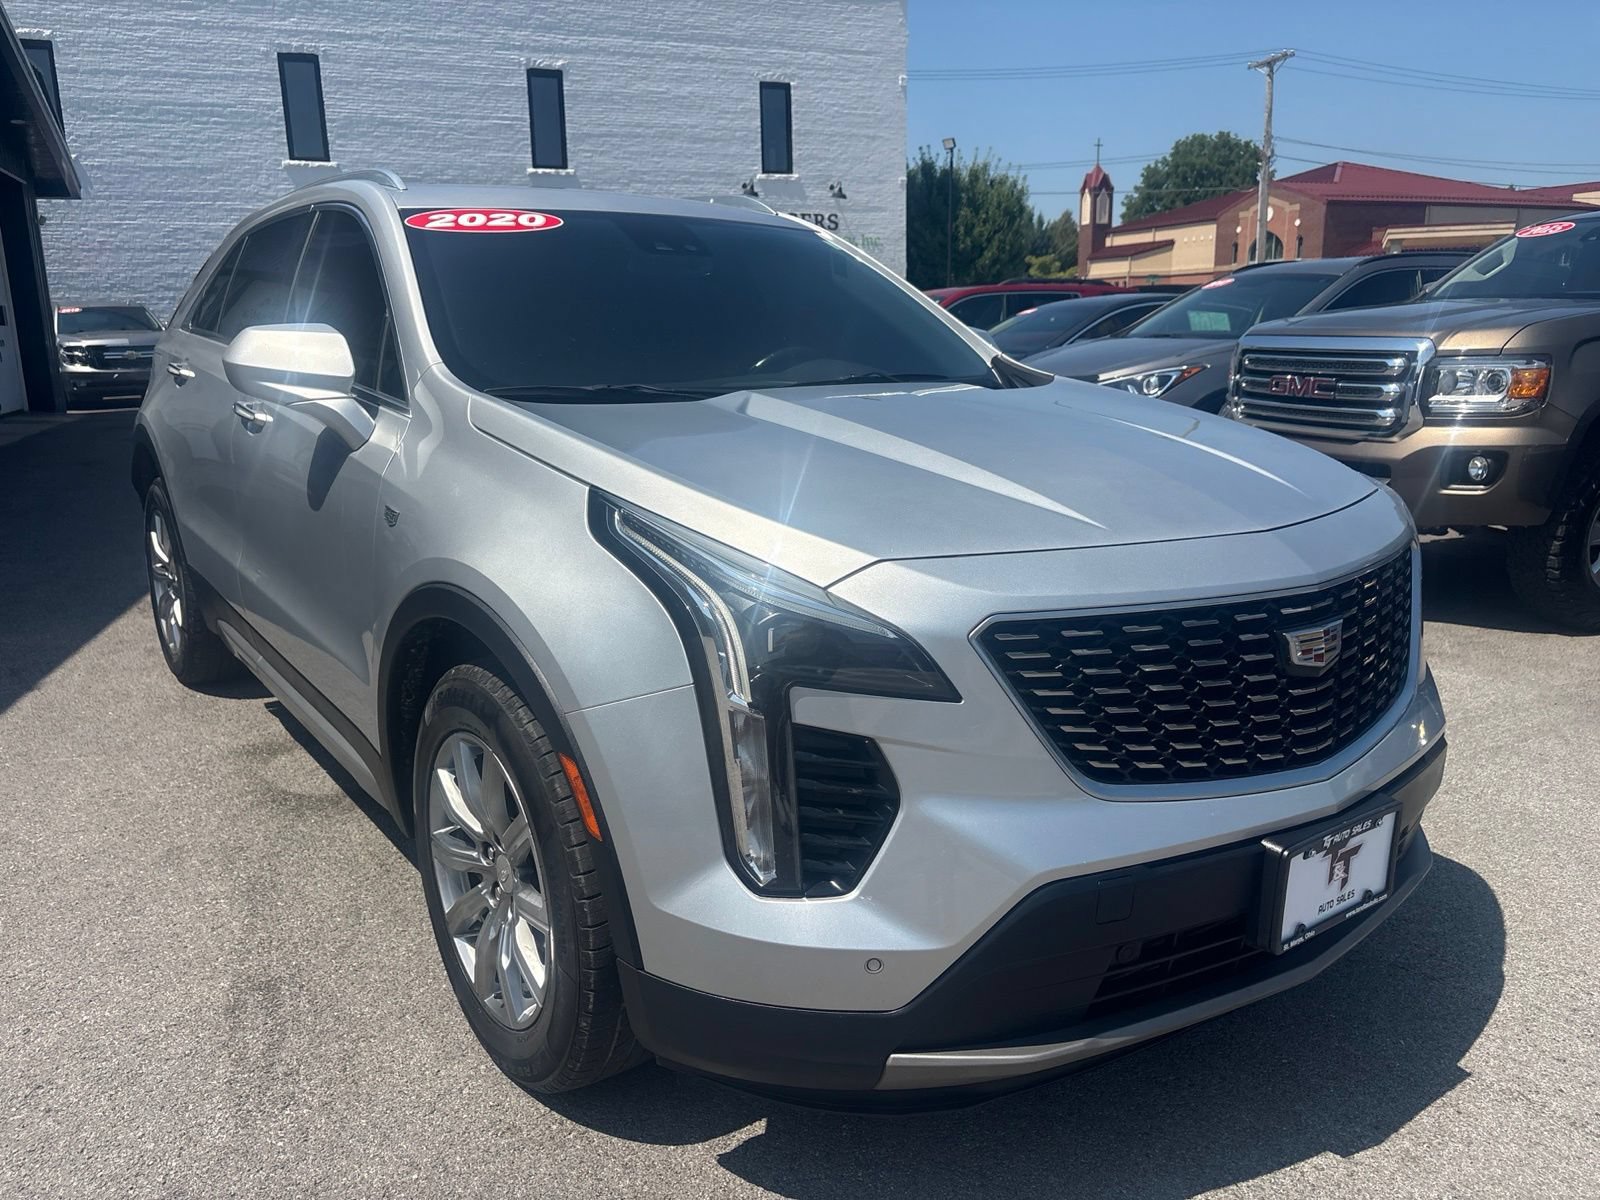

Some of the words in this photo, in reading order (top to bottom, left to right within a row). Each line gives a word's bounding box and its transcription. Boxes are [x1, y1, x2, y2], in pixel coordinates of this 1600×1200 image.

[425, 213, 546, 228] 2020
[1269, 374, 1337, 399] GMC
[1351, 819, 1373, 836] SALES
[1317, 899, 1335, 915] AUTO
[1335, 889, 1356, 906] SALES
